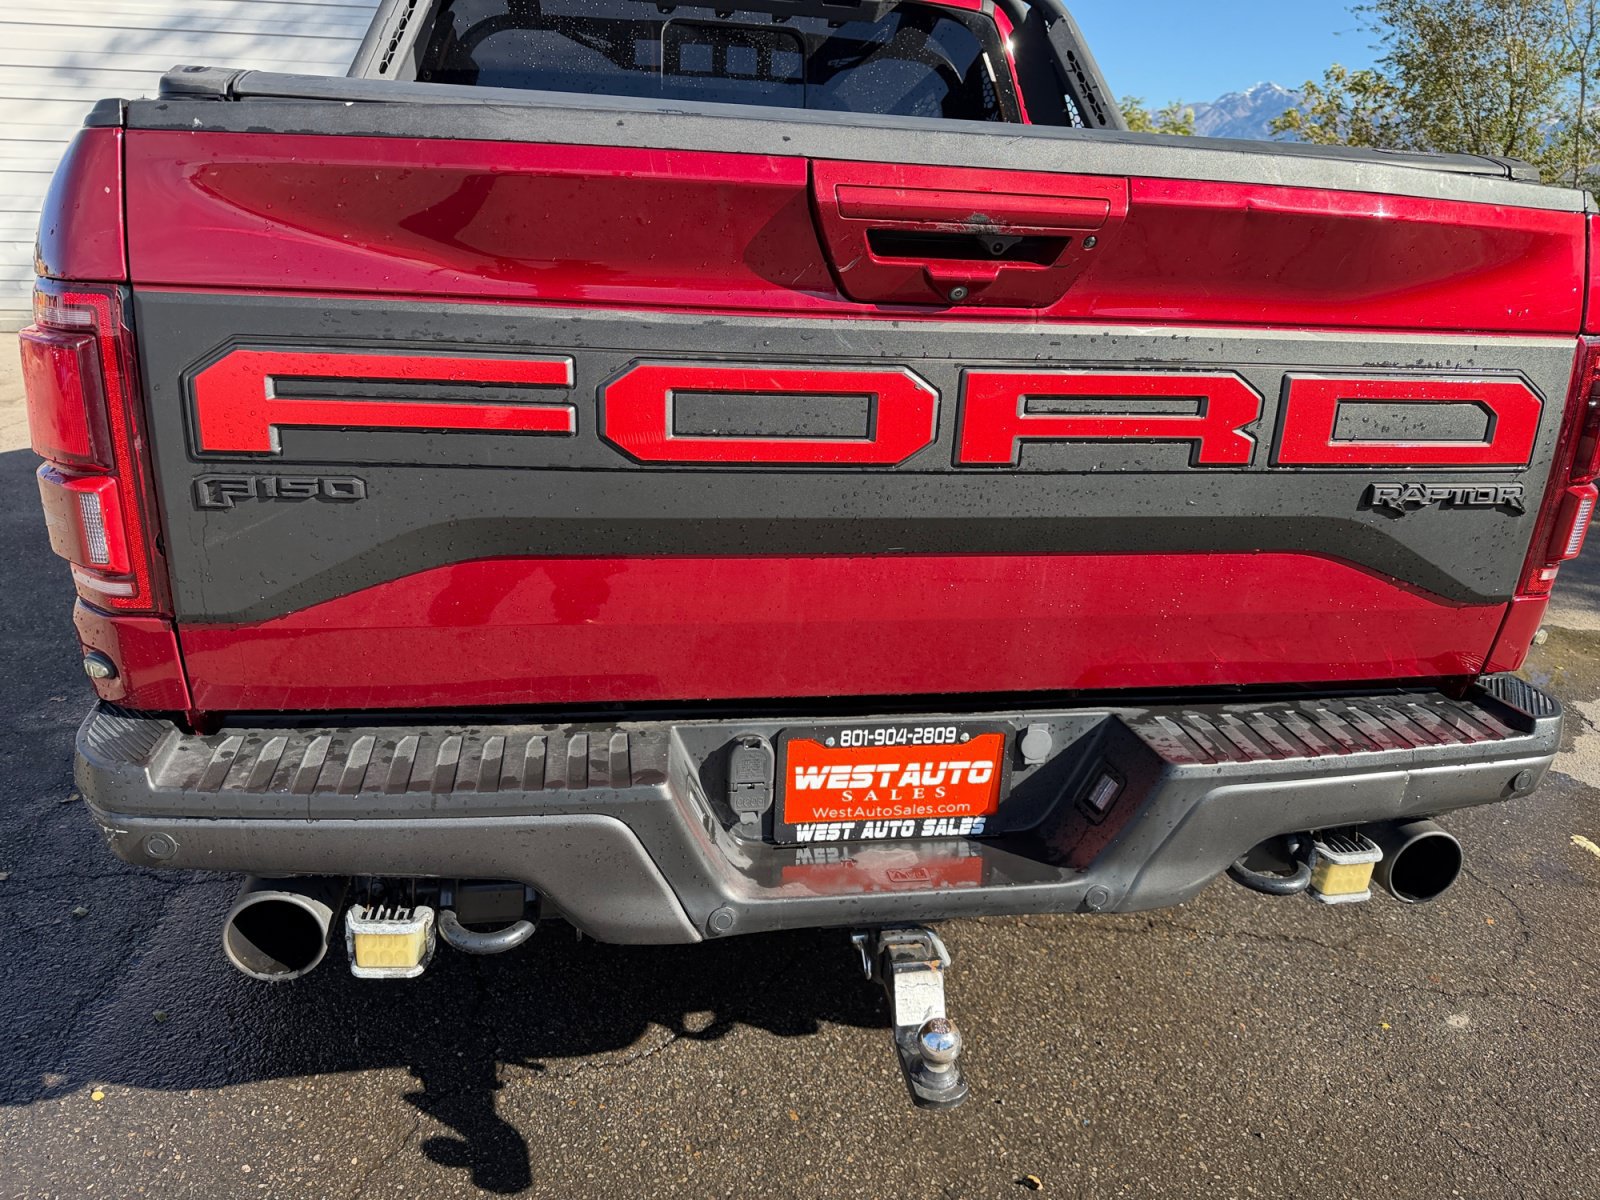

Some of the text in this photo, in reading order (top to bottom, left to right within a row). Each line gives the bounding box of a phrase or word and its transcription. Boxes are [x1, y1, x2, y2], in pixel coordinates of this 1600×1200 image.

[191, 349, 1546, 467] FORD
[1370, 482, 1526, 514] RAPTOR
[840, 727, 957, 748] 801-904-2809
[841, 786, 947, 802] SALES
[812, 802, 971, 819] WestAutoSales.com
[796, 816, 987, 843] WEST AUTO SALES
